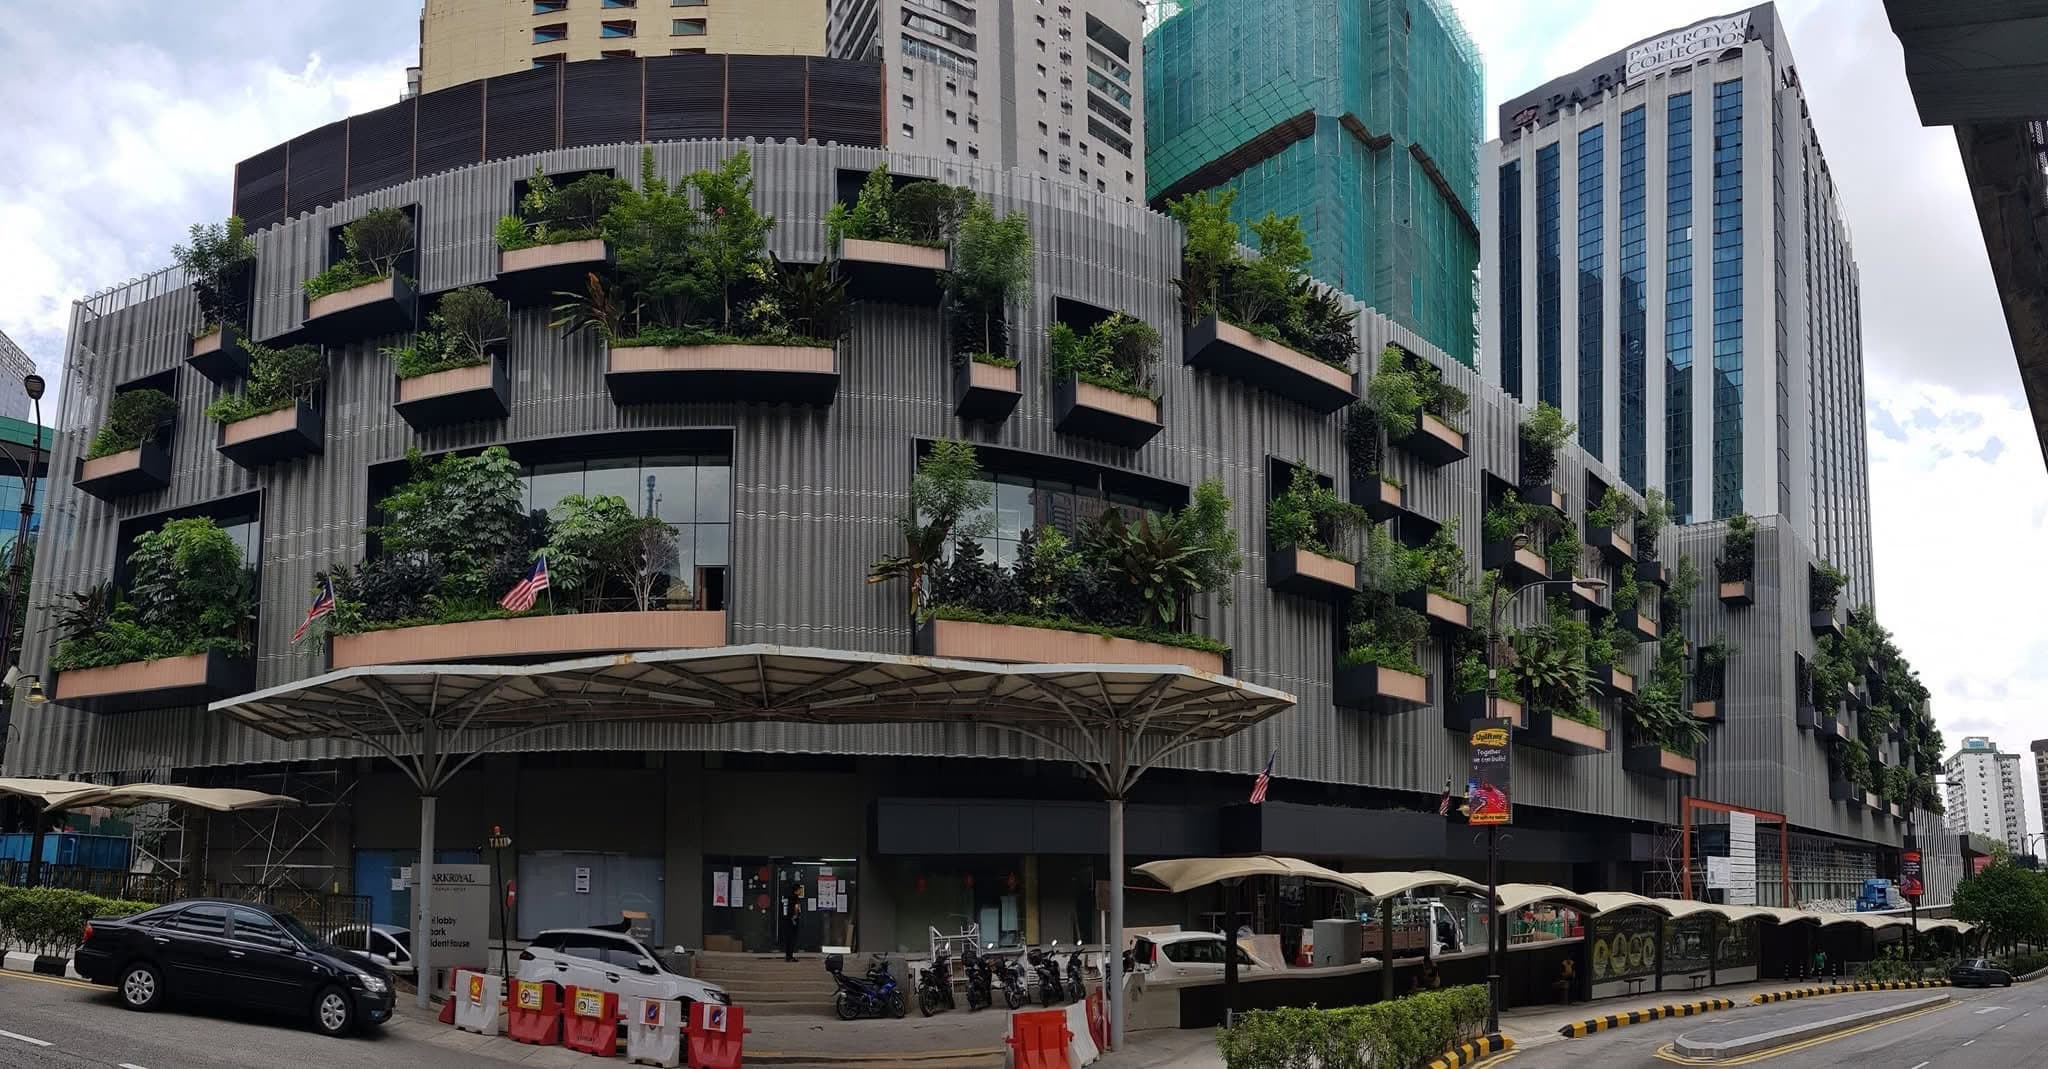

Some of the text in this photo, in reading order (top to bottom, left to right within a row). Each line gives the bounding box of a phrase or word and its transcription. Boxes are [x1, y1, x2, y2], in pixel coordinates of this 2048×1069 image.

[1631, 18, 1745, 60] PARKROYAL
[1628, 32, 1745, 73] COLLECTION
[489, 837, 507, 849] TAXI
[431, 873, 475, 883] ARKROYAL
[436, 916, 456, 927] lobby
[431, 939, 450, 948] ident
